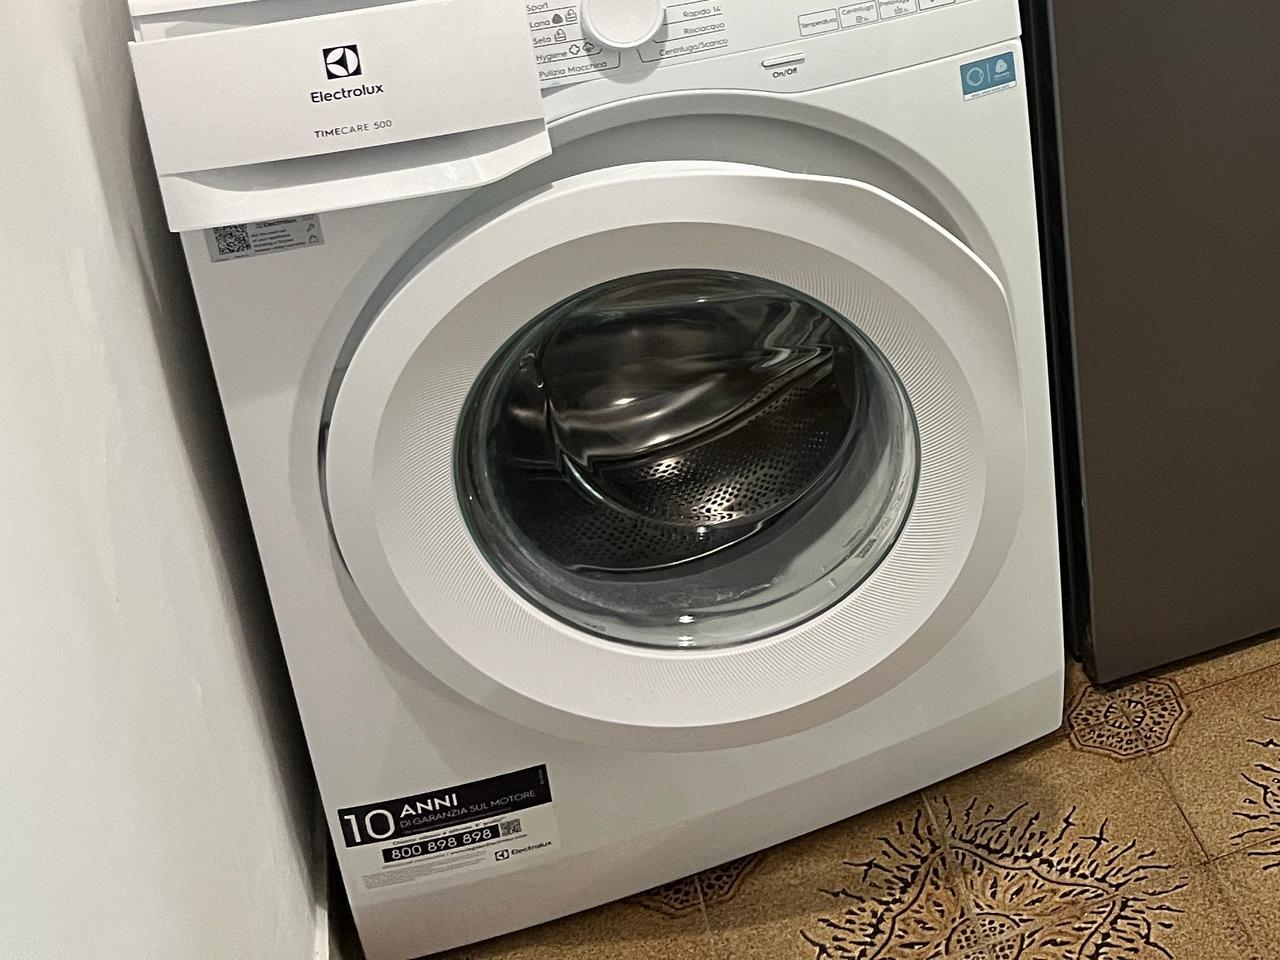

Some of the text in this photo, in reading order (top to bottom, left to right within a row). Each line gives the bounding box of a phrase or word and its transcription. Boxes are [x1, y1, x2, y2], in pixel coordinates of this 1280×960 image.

[526, 2, 549, 12] Sport
[683, 8, 711, 18] Rapido
[529, 20, 551, 29] Lana
[683, 22, 725, 35] Risciacquo
[532, 36, 552, 45] Seta
[536, 51, 567, 62] Hygiene
[539, 61, 607, 78] Pulizia Macchina
[310, 84, 384, 103] Electrolux
[314, 119, 393, 138] TIMECARE 500
[400, 793, 458, 818] ANNI
[413, 808, 468, 827] GARANZIA
[470, 802, 488, 814] SUL
[490, 790, 537, 808] MOTORE
[344, 809, 396, 843] 10
[391, 844, 422, 860] 800
[427, 837, 458, 852] 898
[462, 829, 492, 845] 898
[511, 841, 553, 855] Electrolux
